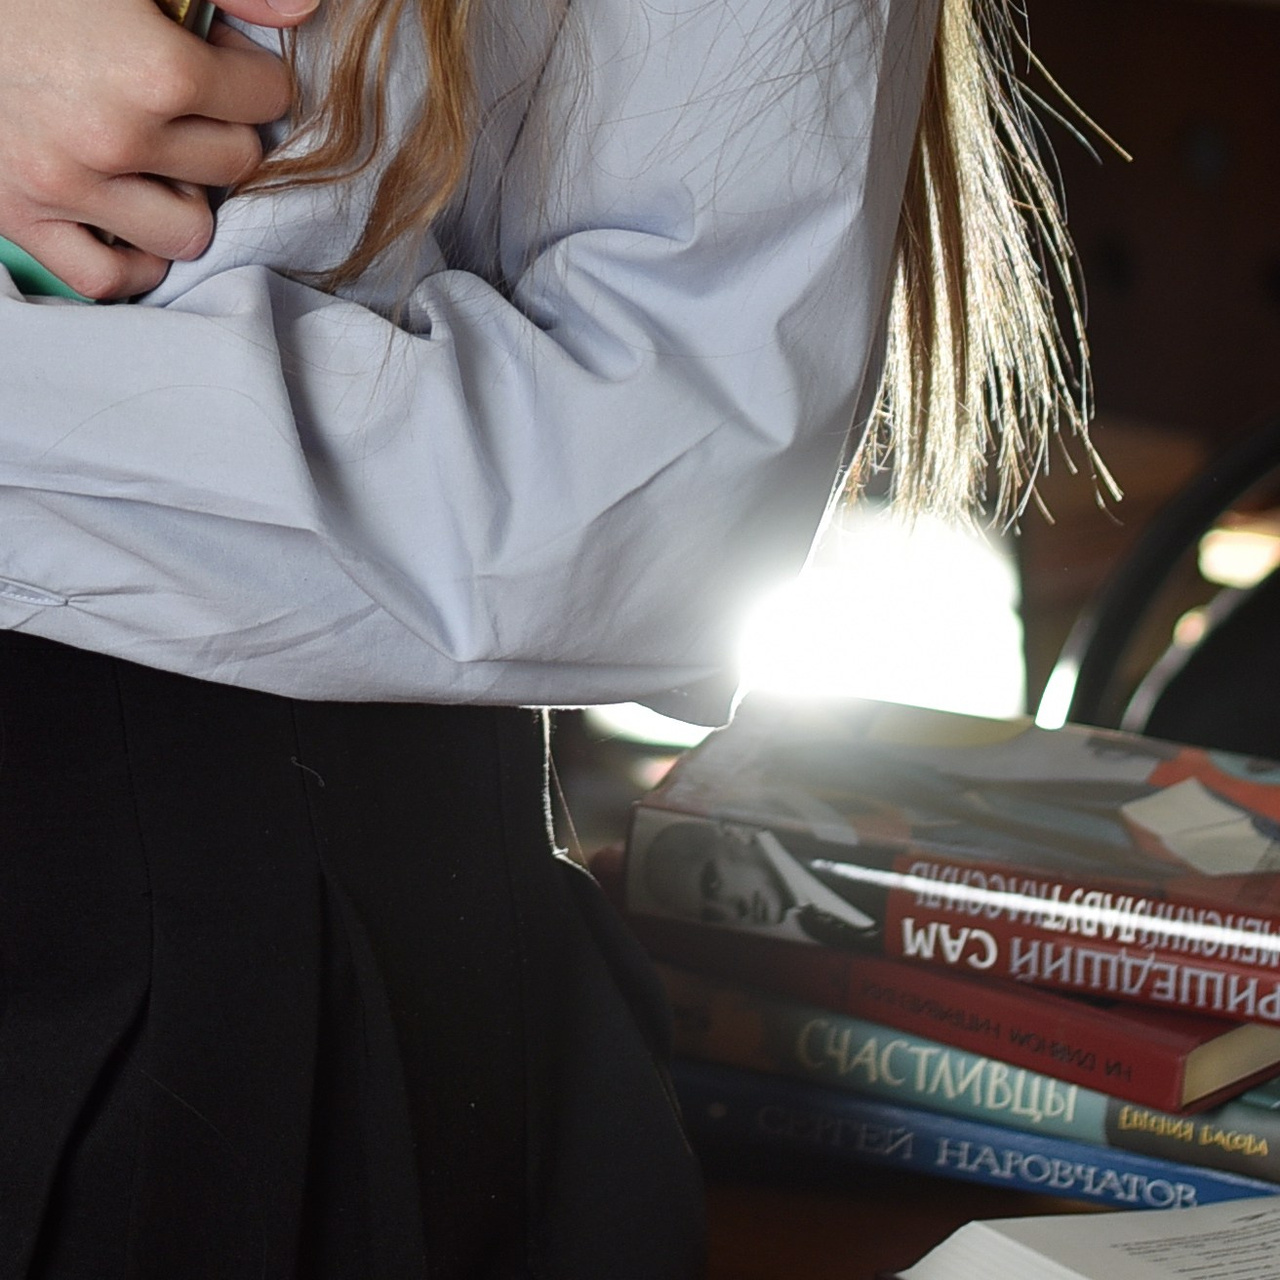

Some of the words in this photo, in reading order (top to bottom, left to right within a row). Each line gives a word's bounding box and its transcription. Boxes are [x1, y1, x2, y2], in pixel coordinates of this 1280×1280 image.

[902, 917, 999, 969] САМ
[797, 1018, 1079, 1124] СЧАСТЛИВЦЫ
[1118, 1104, 1194, 1143] ЕВГЕНИЯ
[1198, 1124, 1269, 1157] БАСОВА
[935, 1137, 1198, 1208] НАРОВЧАТОВ
